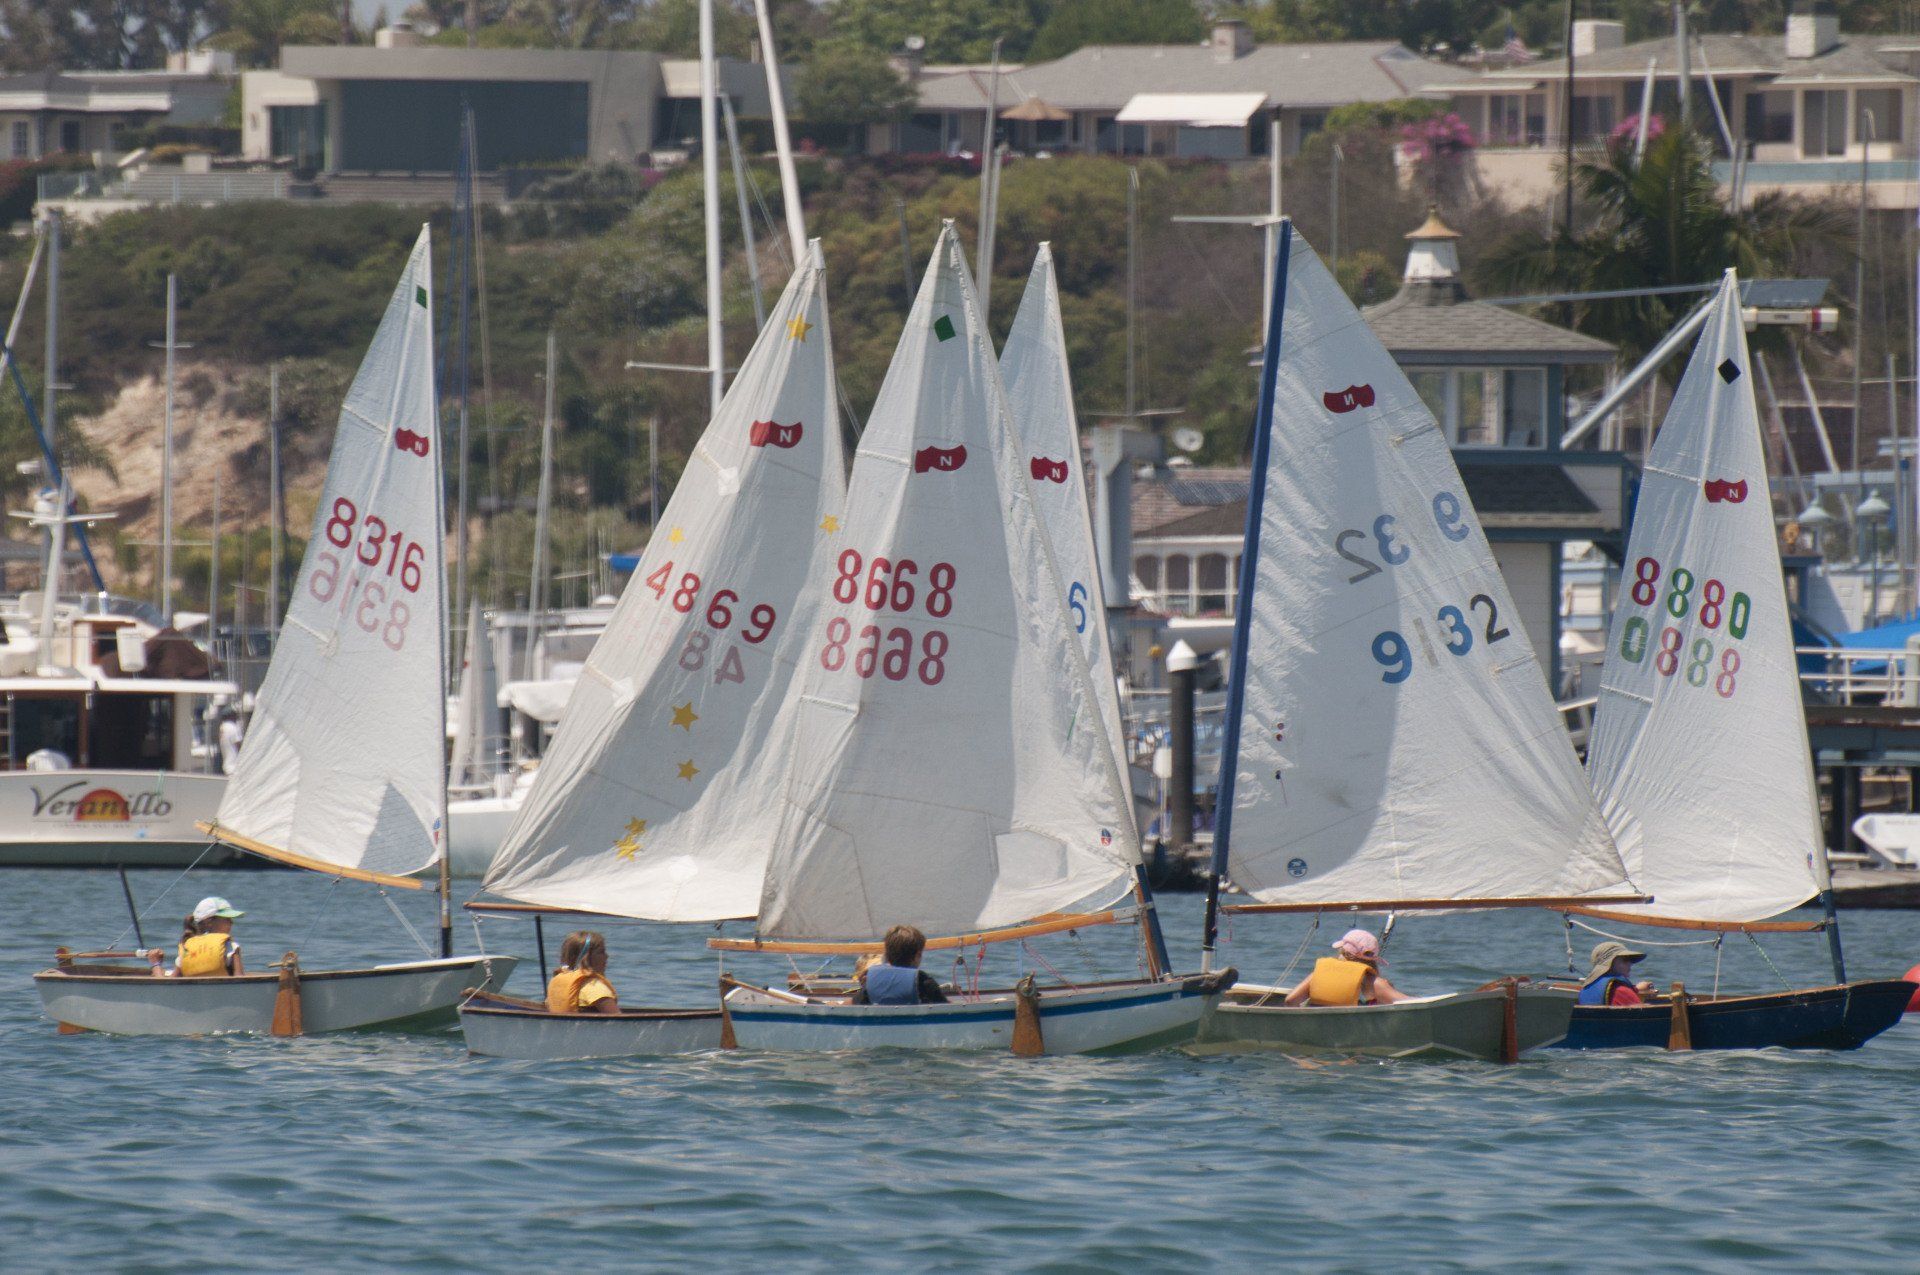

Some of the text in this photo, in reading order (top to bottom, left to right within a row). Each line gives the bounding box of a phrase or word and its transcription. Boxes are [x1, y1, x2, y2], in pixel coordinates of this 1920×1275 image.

[779, 428, 793, 444] N
[326, 497, 425, 593] 8316
[833, 548, 956, 618] 8668
[646, 560, 776, 644] 4869
[1632, 557, 1751, 640] 8880
[30, 781, 172, 816] Veranillo
